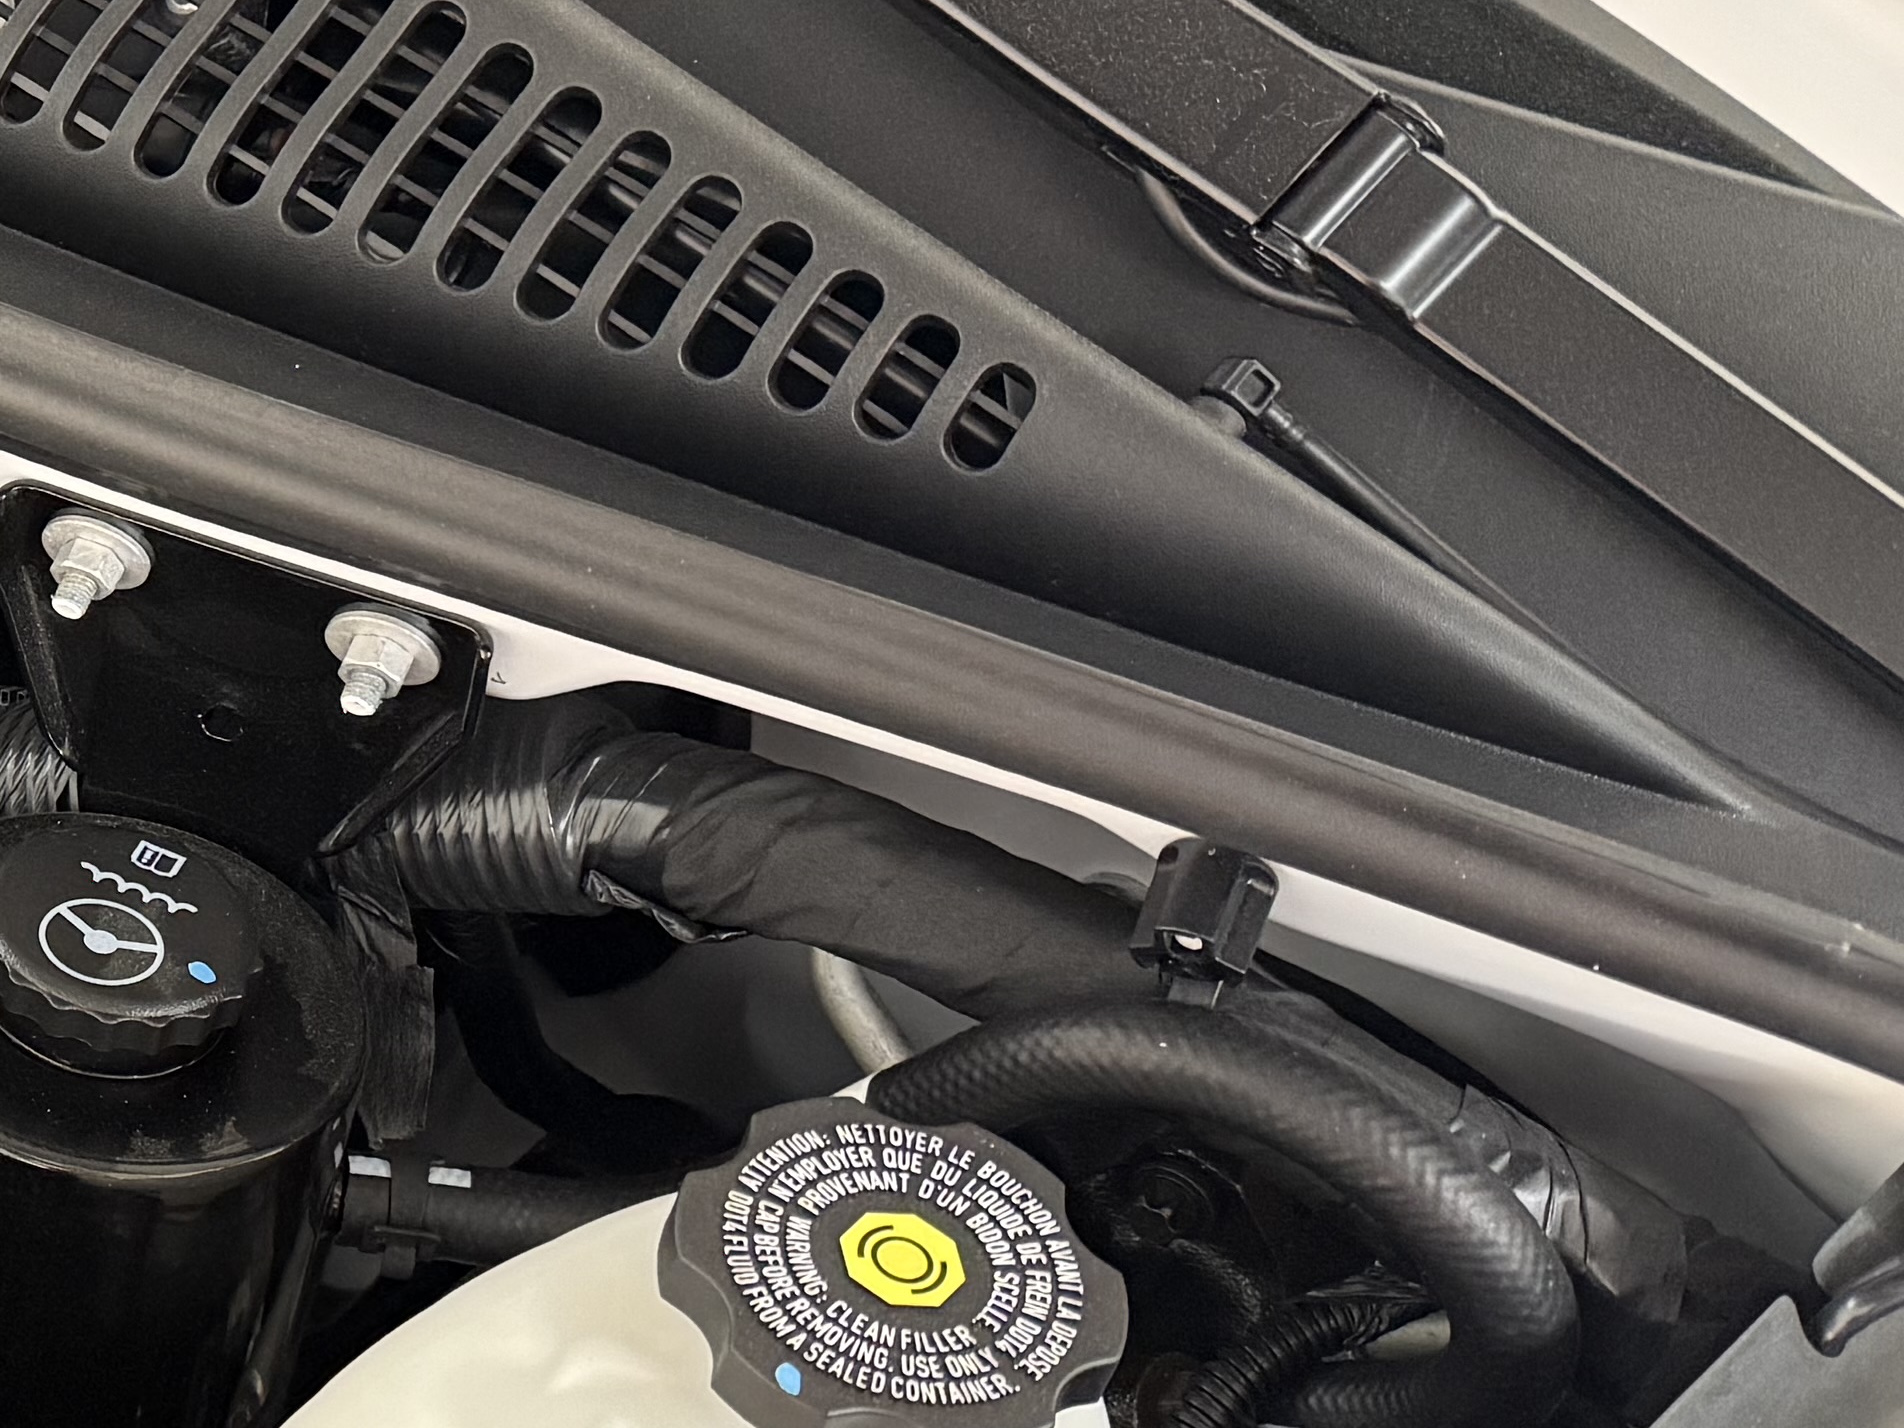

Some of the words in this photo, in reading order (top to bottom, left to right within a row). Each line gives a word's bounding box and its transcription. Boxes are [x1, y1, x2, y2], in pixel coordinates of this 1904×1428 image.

[738, 1129, 831, 1193] ATTENTION:
[835, 1123, 944, 1157] NETTOYER
[882, 1147, 923, 1175] QUE
[947, 1145, 975, 1170] LE
[767, 1146, 876, 1203] N'EMPLOYER
[930, 1160, 962, 1187] DU
[722, 1190, 754, 1232] DOT4
[754, 1199, 785, 1234] CAP
[797, 1170, 910, 1216] PROVENANT
[918, 1177, 971, 1217] D'UN
[965, 1212, 1017, 1266] BIDON
[962, 1177, 1033, 1241] LIQUIDE
[977, 1160, 1061, 1237] BOUCHON
[722, 1233, 760, 1286] FLUID
[753, 1233, 801, 1302] BEFORE
[1015, 1241, 1047, 1266] DE
[1046, 1239, 1084, 1295] AVANT
[785, 1215, 829, 1304] WARNING:
[826, 1299, 896, 1348] CLEAN
[901, 1324, 978, 1354] FILLER
[1021, 1269, 1053, 1322] FREIN
[741, 1287, 798, 1339] FROM
[1056, 1297, 1084, 1321] LA
[785, 1297, 895, 1373] REMOVING.
[785, 1331, 808, 1352] A
[995, 1317, 1042, 1358] DOT4
[802, 1342, 887, 1394] SEALED
[901, 1353, 944, 1380] USE
[944, 1346, 1000, 1379] ONLY
[890, 1373, 1022, 1405] CONTAINER.
